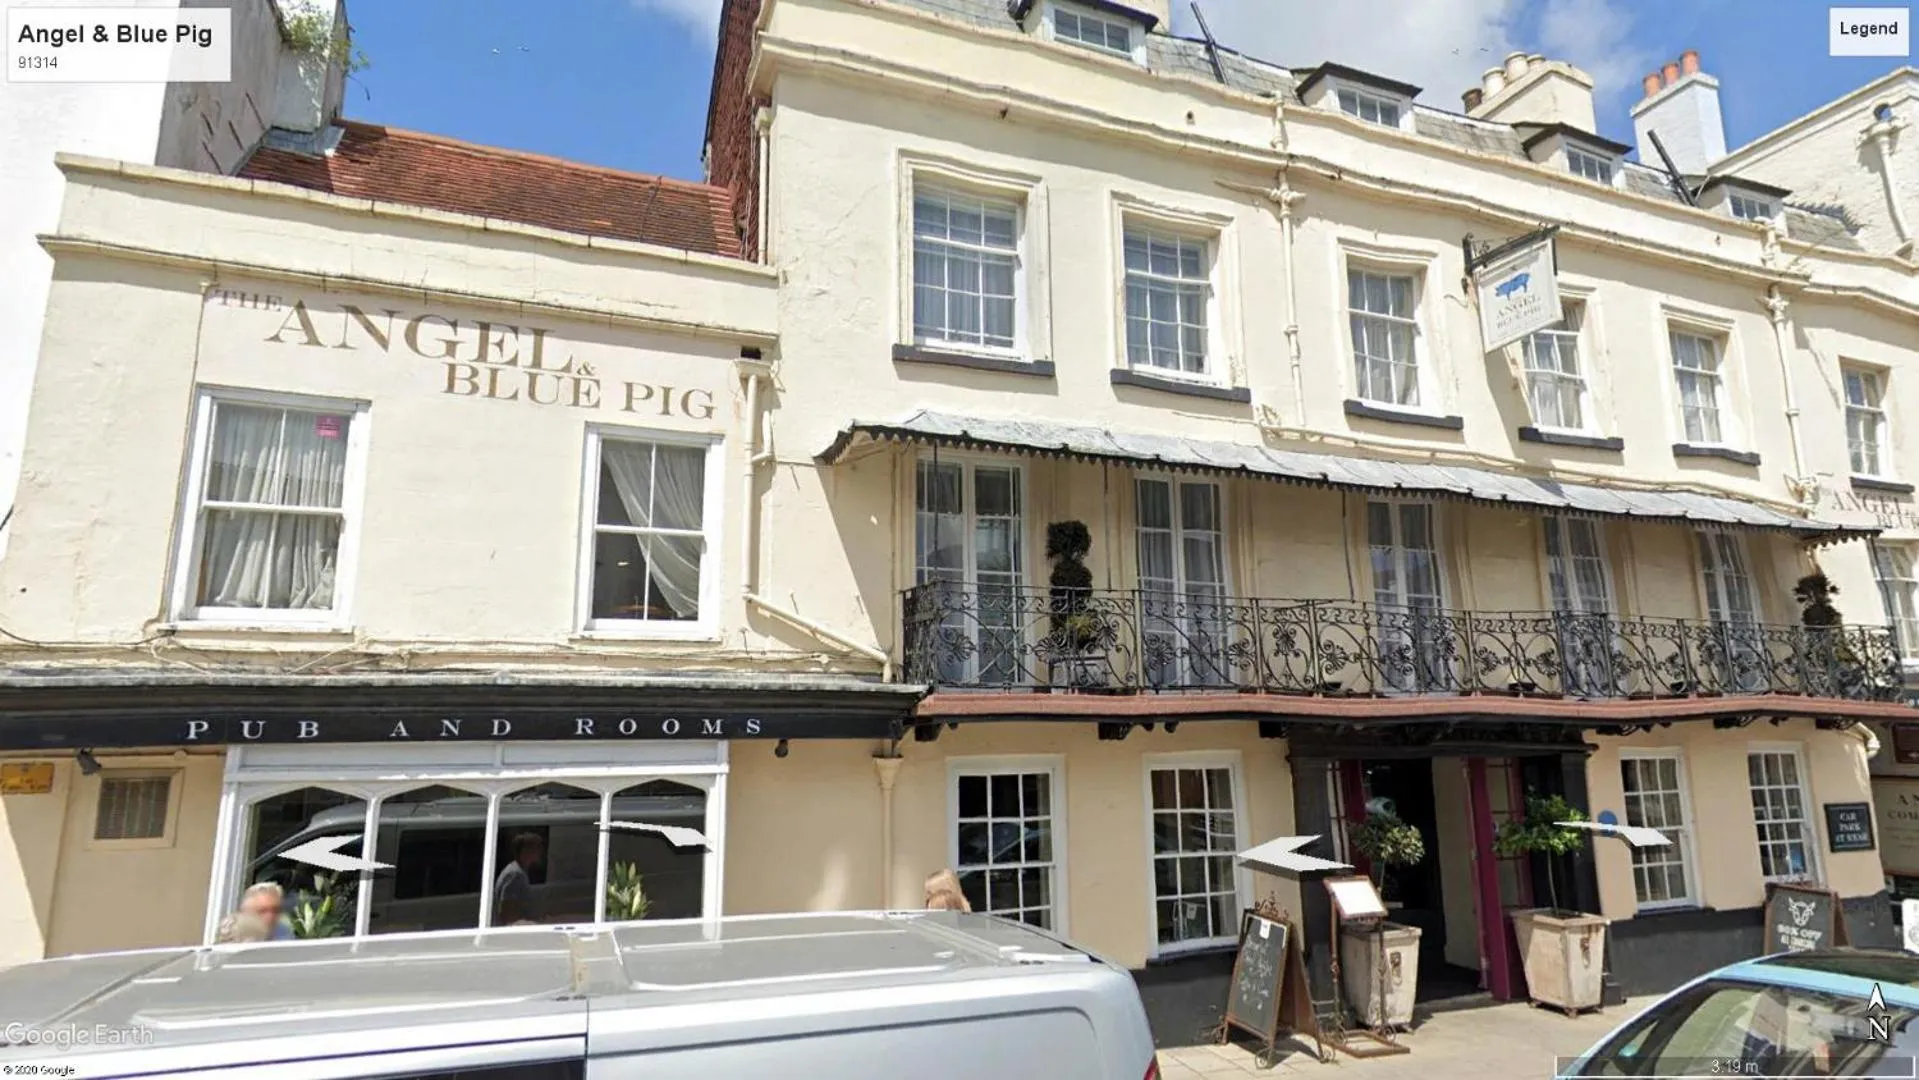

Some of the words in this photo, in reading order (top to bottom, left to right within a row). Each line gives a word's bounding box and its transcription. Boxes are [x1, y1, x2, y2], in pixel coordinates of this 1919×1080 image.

[1498, 294, 1543, 319] ANGEL
[214, 288, 282, 312] THE
[263, 298, 574, 374] ANGEL
[576, 361, 597, 377] &
[441, 362, 601, 409] BLUE
[621, 381, 718, 420] PIG
[1832, 490, 1911, 516] ANGEL
[187, 720, 320, 740] PUB
[390, 718, 512, 737] AND
[575, 717, 762, 736] ROOMS
[1839, 812, 1857, 821] CAR
[1839, 822, 1861, 832] PARK
